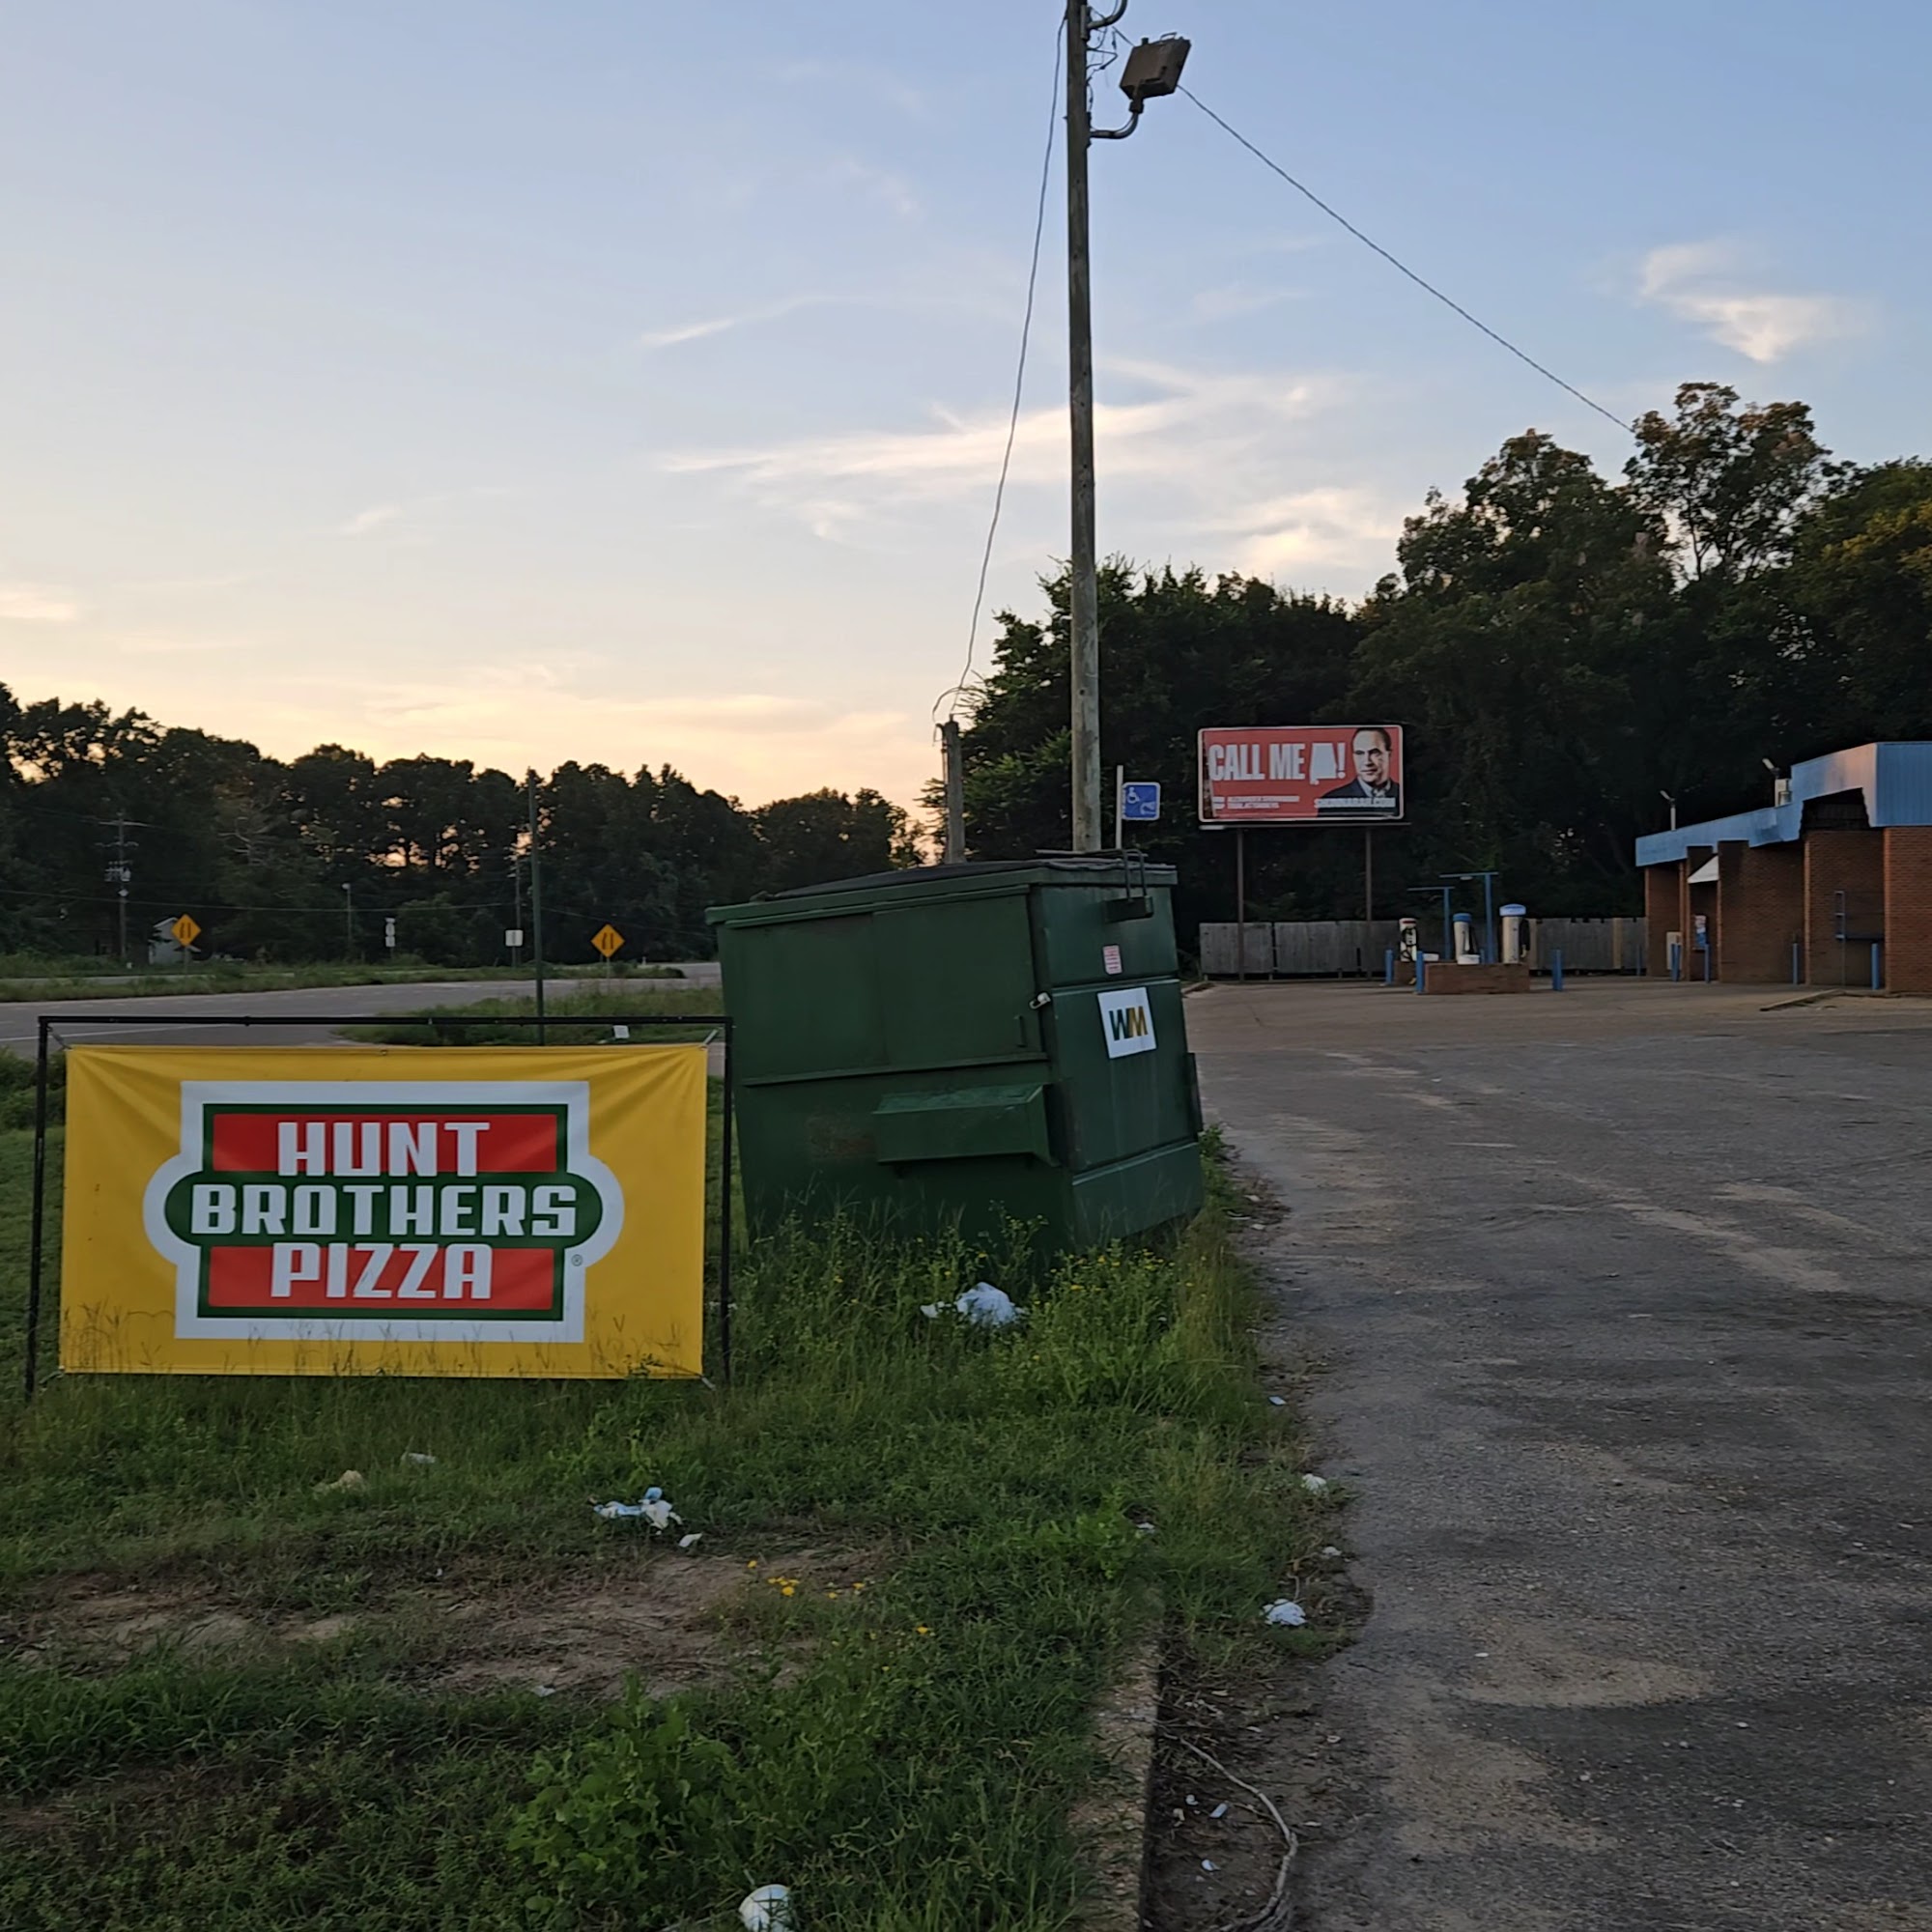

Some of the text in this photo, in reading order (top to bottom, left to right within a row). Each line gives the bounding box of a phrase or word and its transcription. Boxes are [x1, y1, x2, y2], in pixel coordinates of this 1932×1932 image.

[1208, 743, 1265, 781] CALL
[1269, 743, 1305, 781] ME
[1108, 1005, 1149, 1041] WM
[277, 1122, 490, 1177] HUNT
[191, 1184, 577, 1236] BROTHERS
[270, 1242, 493, 1299] PIZZA
